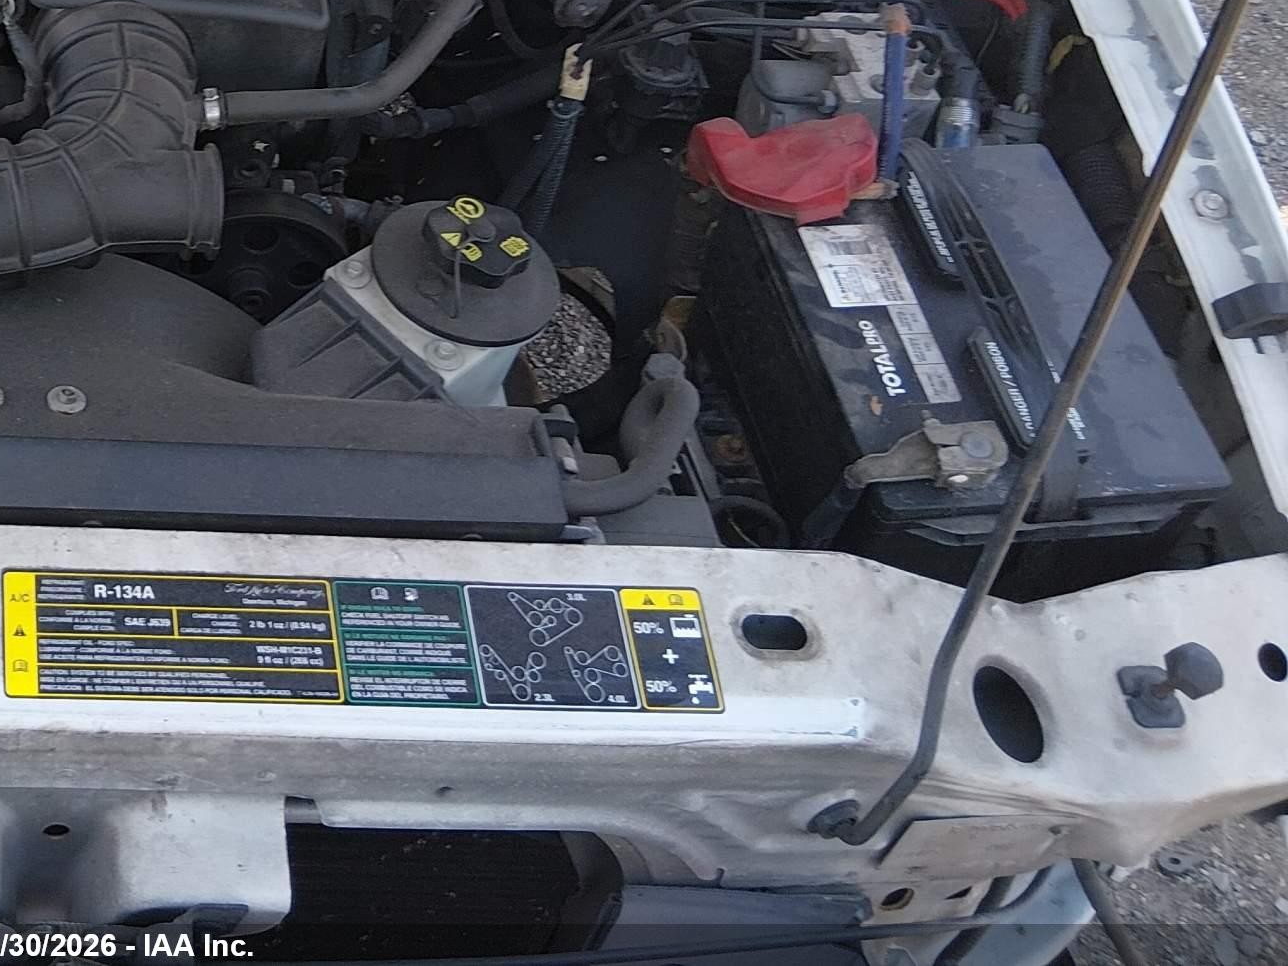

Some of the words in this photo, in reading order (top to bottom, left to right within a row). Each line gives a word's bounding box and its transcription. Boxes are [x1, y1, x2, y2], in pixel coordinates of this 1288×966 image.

[93, 584, 155, 600] R-134A
[124, 617, 147, 627] SAE
[633, 621, 664, 634] 50%
[646, 680, 677, 693] 50%
